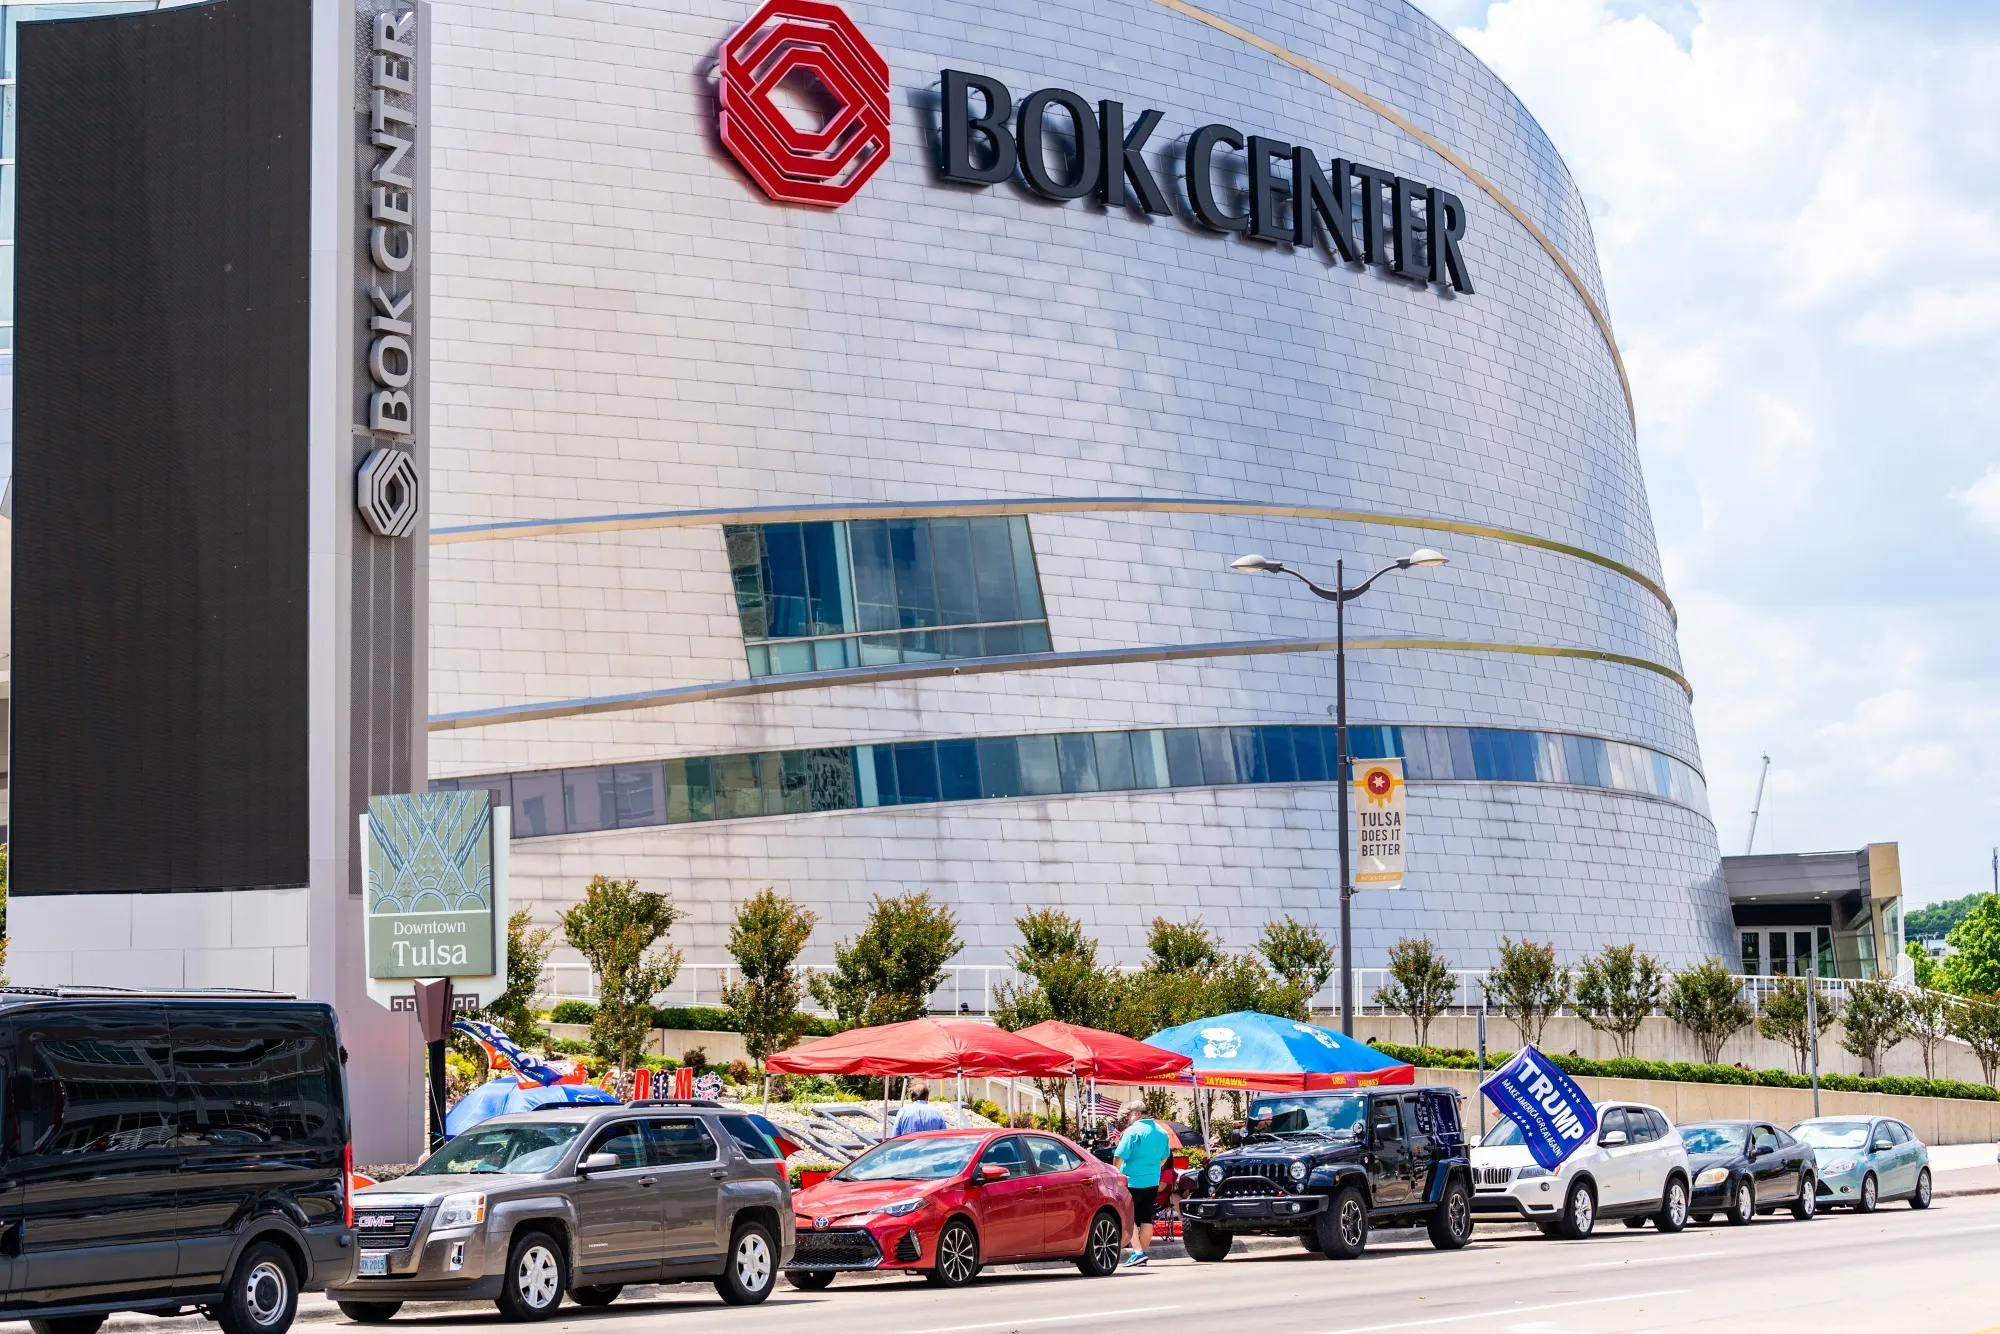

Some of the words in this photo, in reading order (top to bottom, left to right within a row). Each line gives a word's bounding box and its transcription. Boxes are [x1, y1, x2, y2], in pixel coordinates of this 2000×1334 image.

[371, 11, 414, 273] CENTER
[941, 68, 1172, 217] BOK
[1185, 123, 1475, 295] CENTER
[370, 286, 413, 435] BOK
[1361, 812, 1401, 827] TULSA
[1361, 829, 1388, 842] DOES
[1391, 828, 1400, 841] IT
[1361, 844, 1400, 856] BETTER
[394, 920, 466, 935] Downtown
[392, 938, 468, 967] Tulsa
[1204, 1076, 1248, 1087] JAYHAWKS
[1517, 1057, 1585, 1140] TRUMP
[1502, 1079, 1520, 1098] MAKE
[1516, 1096, 1539, 1118] AMERICA
[1536, 1117, 1551, 1139] GREAT
[1546, 1137, 1563, 1158] AGAIN!
[358, 1215, 394, 1227] GMC
